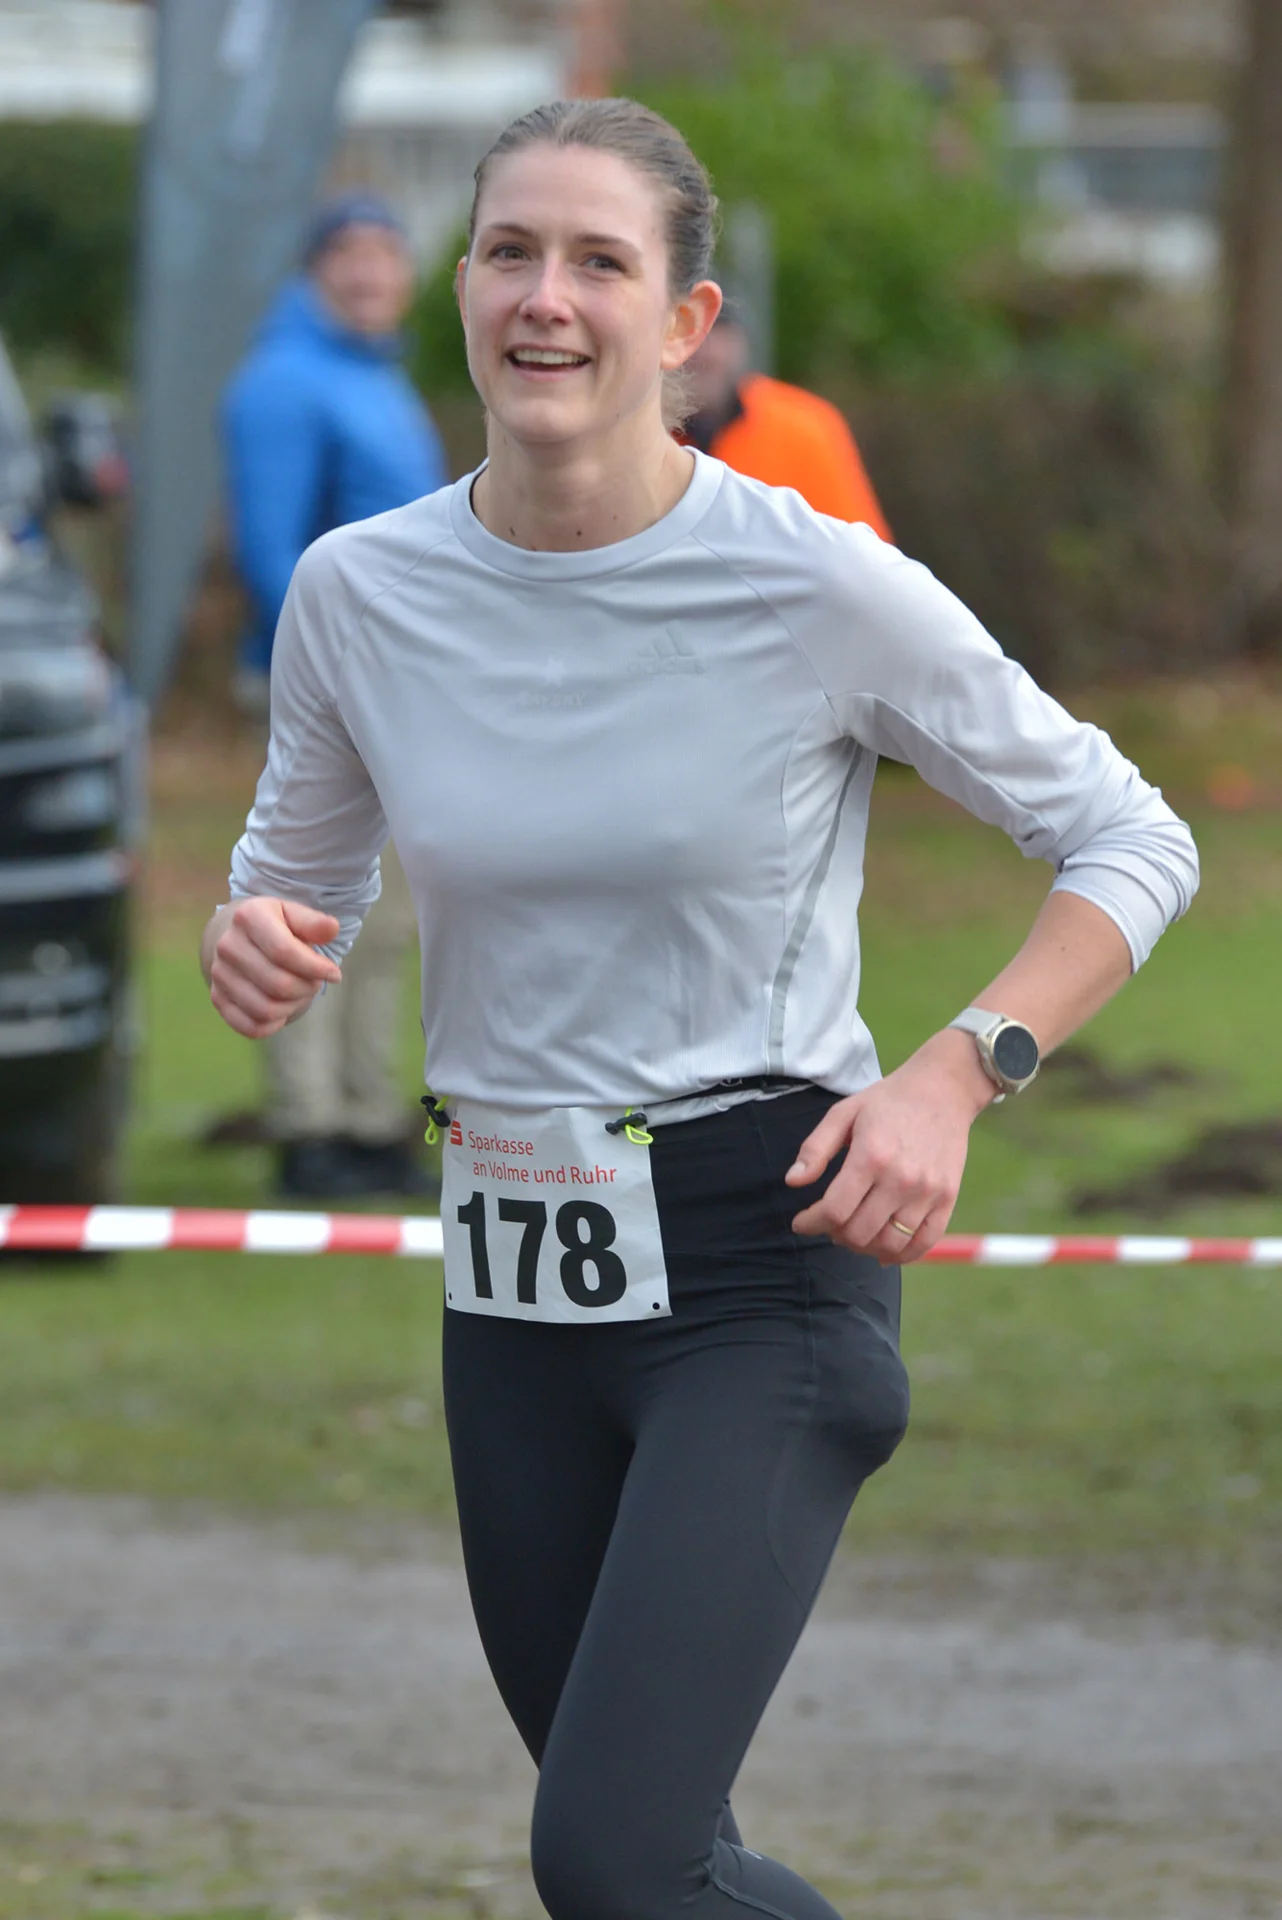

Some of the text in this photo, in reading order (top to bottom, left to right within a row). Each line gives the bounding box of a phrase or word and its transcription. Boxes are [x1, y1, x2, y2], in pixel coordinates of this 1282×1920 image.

[468, 1130, 534, 1156] Sparkasse
[473, 1160, 617, 1185] an Volme und Ruhr
[457, 1190, 628, 1308] 178
